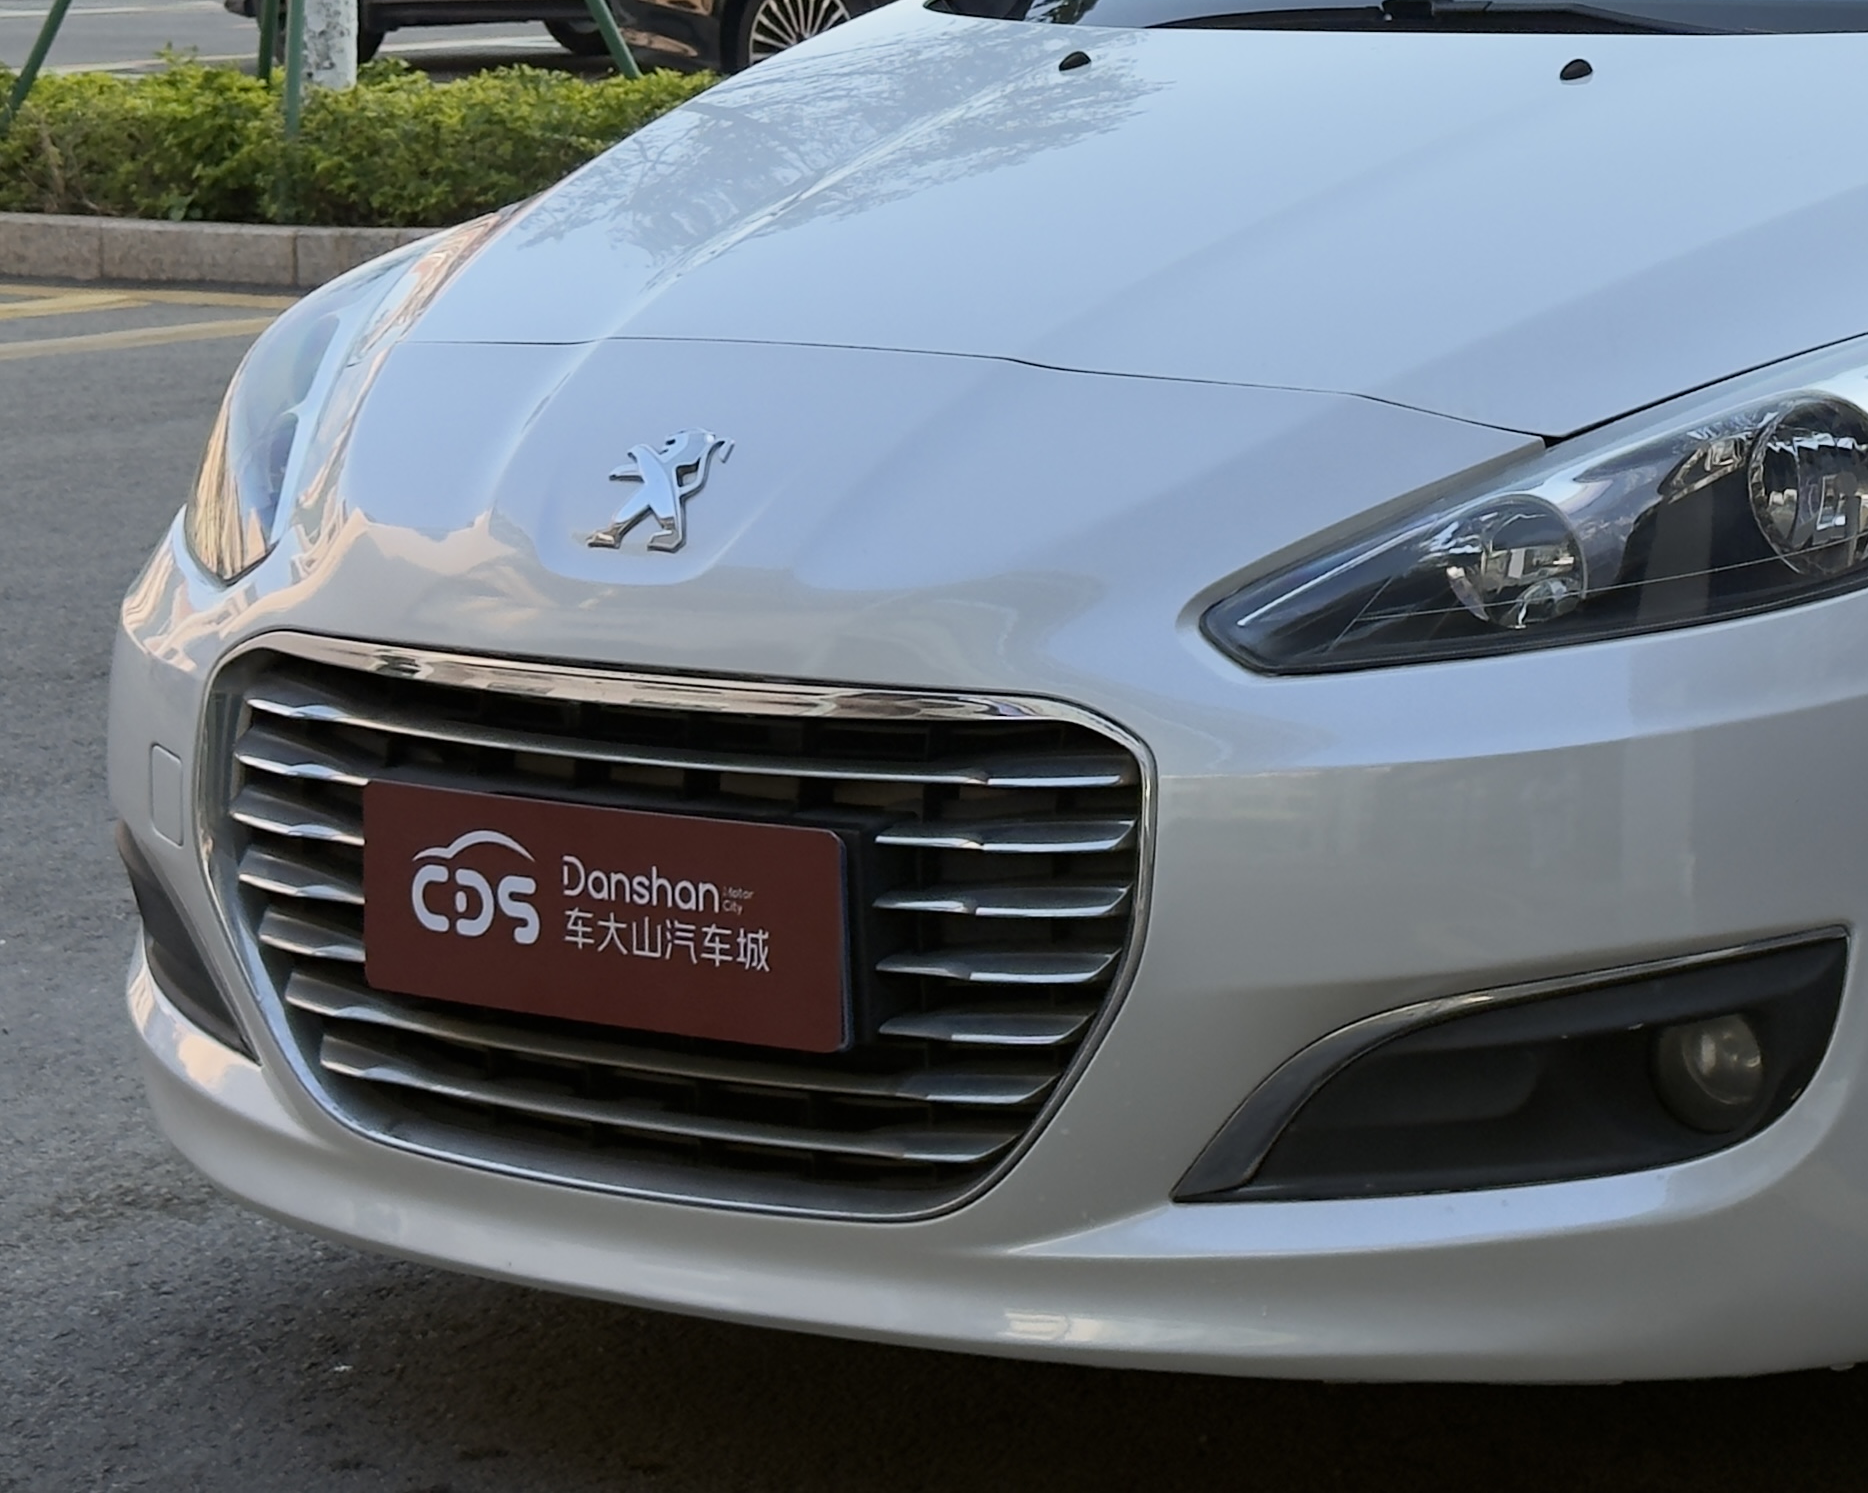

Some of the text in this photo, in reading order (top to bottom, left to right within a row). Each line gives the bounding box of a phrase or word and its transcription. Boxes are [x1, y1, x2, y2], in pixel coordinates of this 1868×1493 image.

[562, 854, 720, 913] Danshan
[722, 899, 743, 916] City
[563, 907, 771, 973] 车大山汽车城
